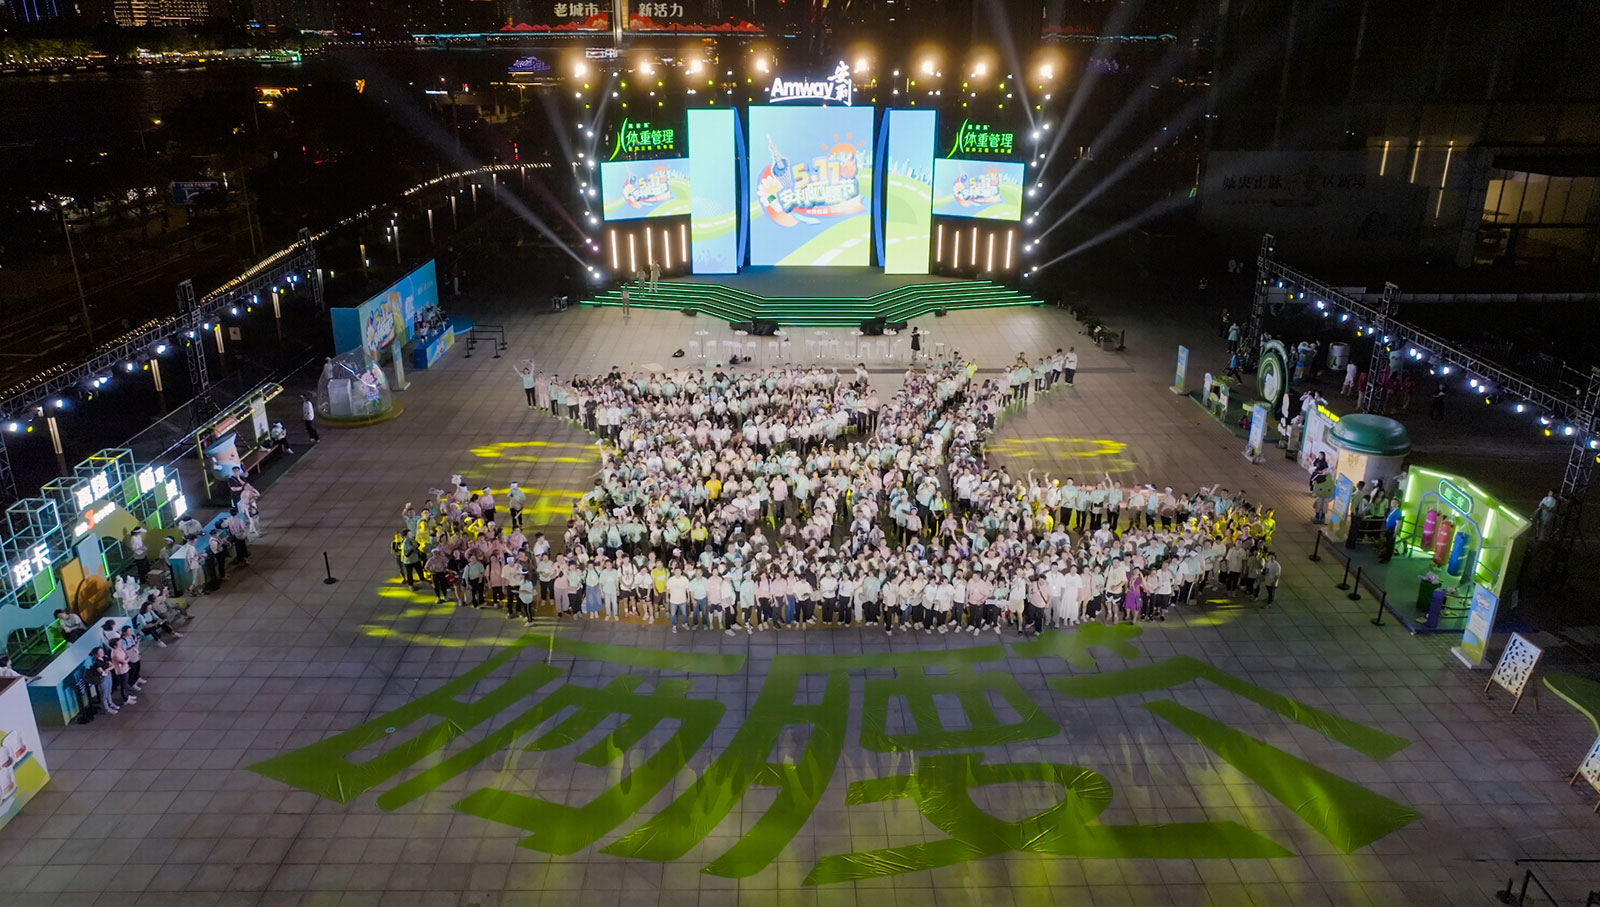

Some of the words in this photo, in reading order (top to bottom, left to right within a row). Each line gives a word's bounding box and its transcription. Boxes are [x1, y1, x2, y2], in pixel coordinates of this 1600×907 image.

[554, 3, 599, 17] 老城市
[638, 3, 684, 17] 新活力
[770, 77, 834, 100] Amway
[827, 60, 852, 106] 安利
[626, 129, 674, 147] 体重管理
[963, 132, 1014, 149] 体重管理
[793, 157, 842, 189] 5.11
